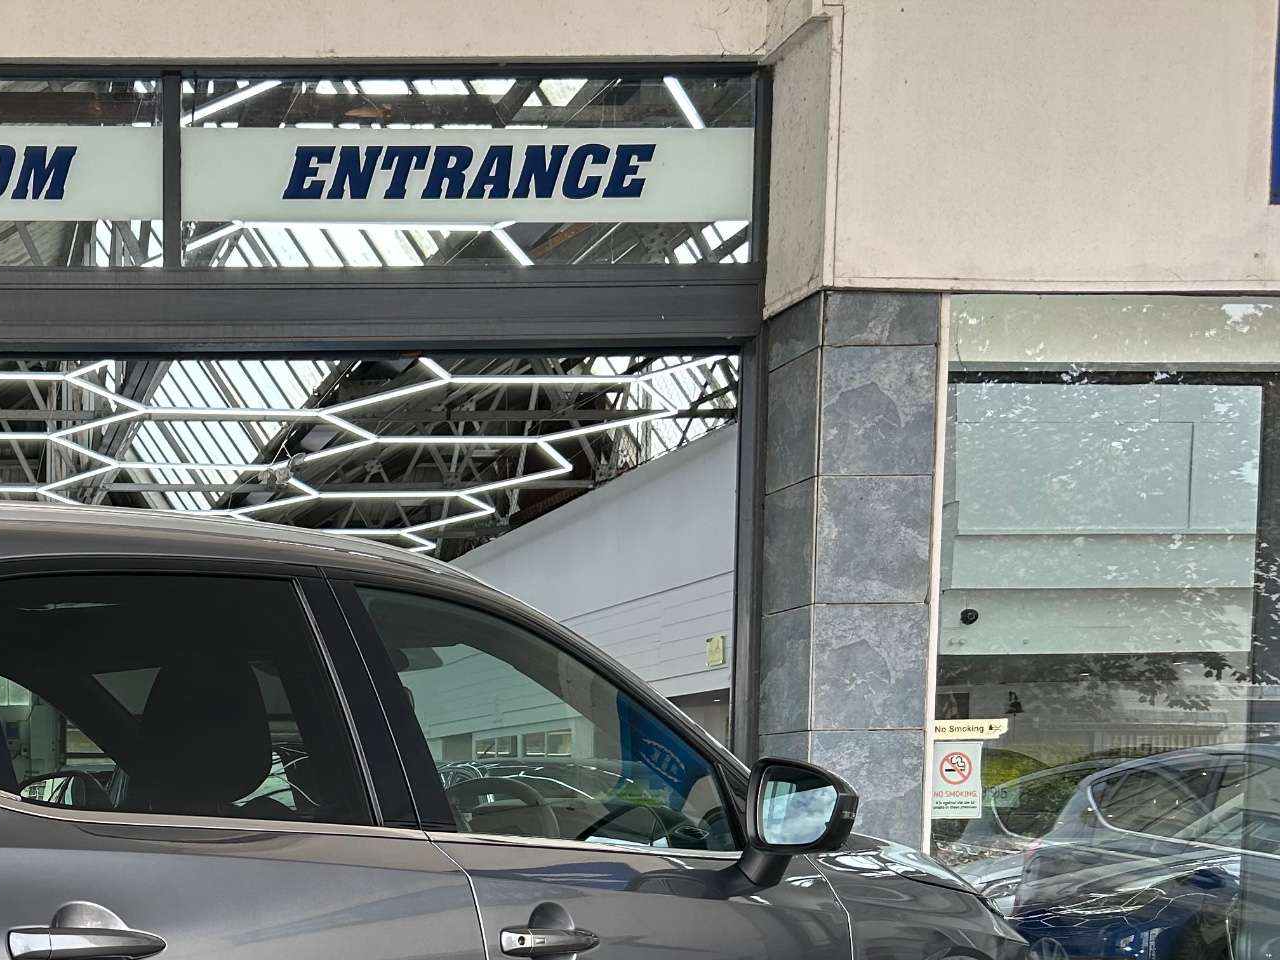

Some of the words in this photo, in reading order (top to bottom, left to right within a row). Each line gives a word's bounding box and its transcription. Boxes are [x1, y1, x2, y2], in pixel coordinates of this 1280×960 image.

[282, 143, 657, 200] ENTRANCE
[934, 725, 947, 733] No
[949, 725, 985, 734] Smoking
[933, 790, 944, 798] NO
